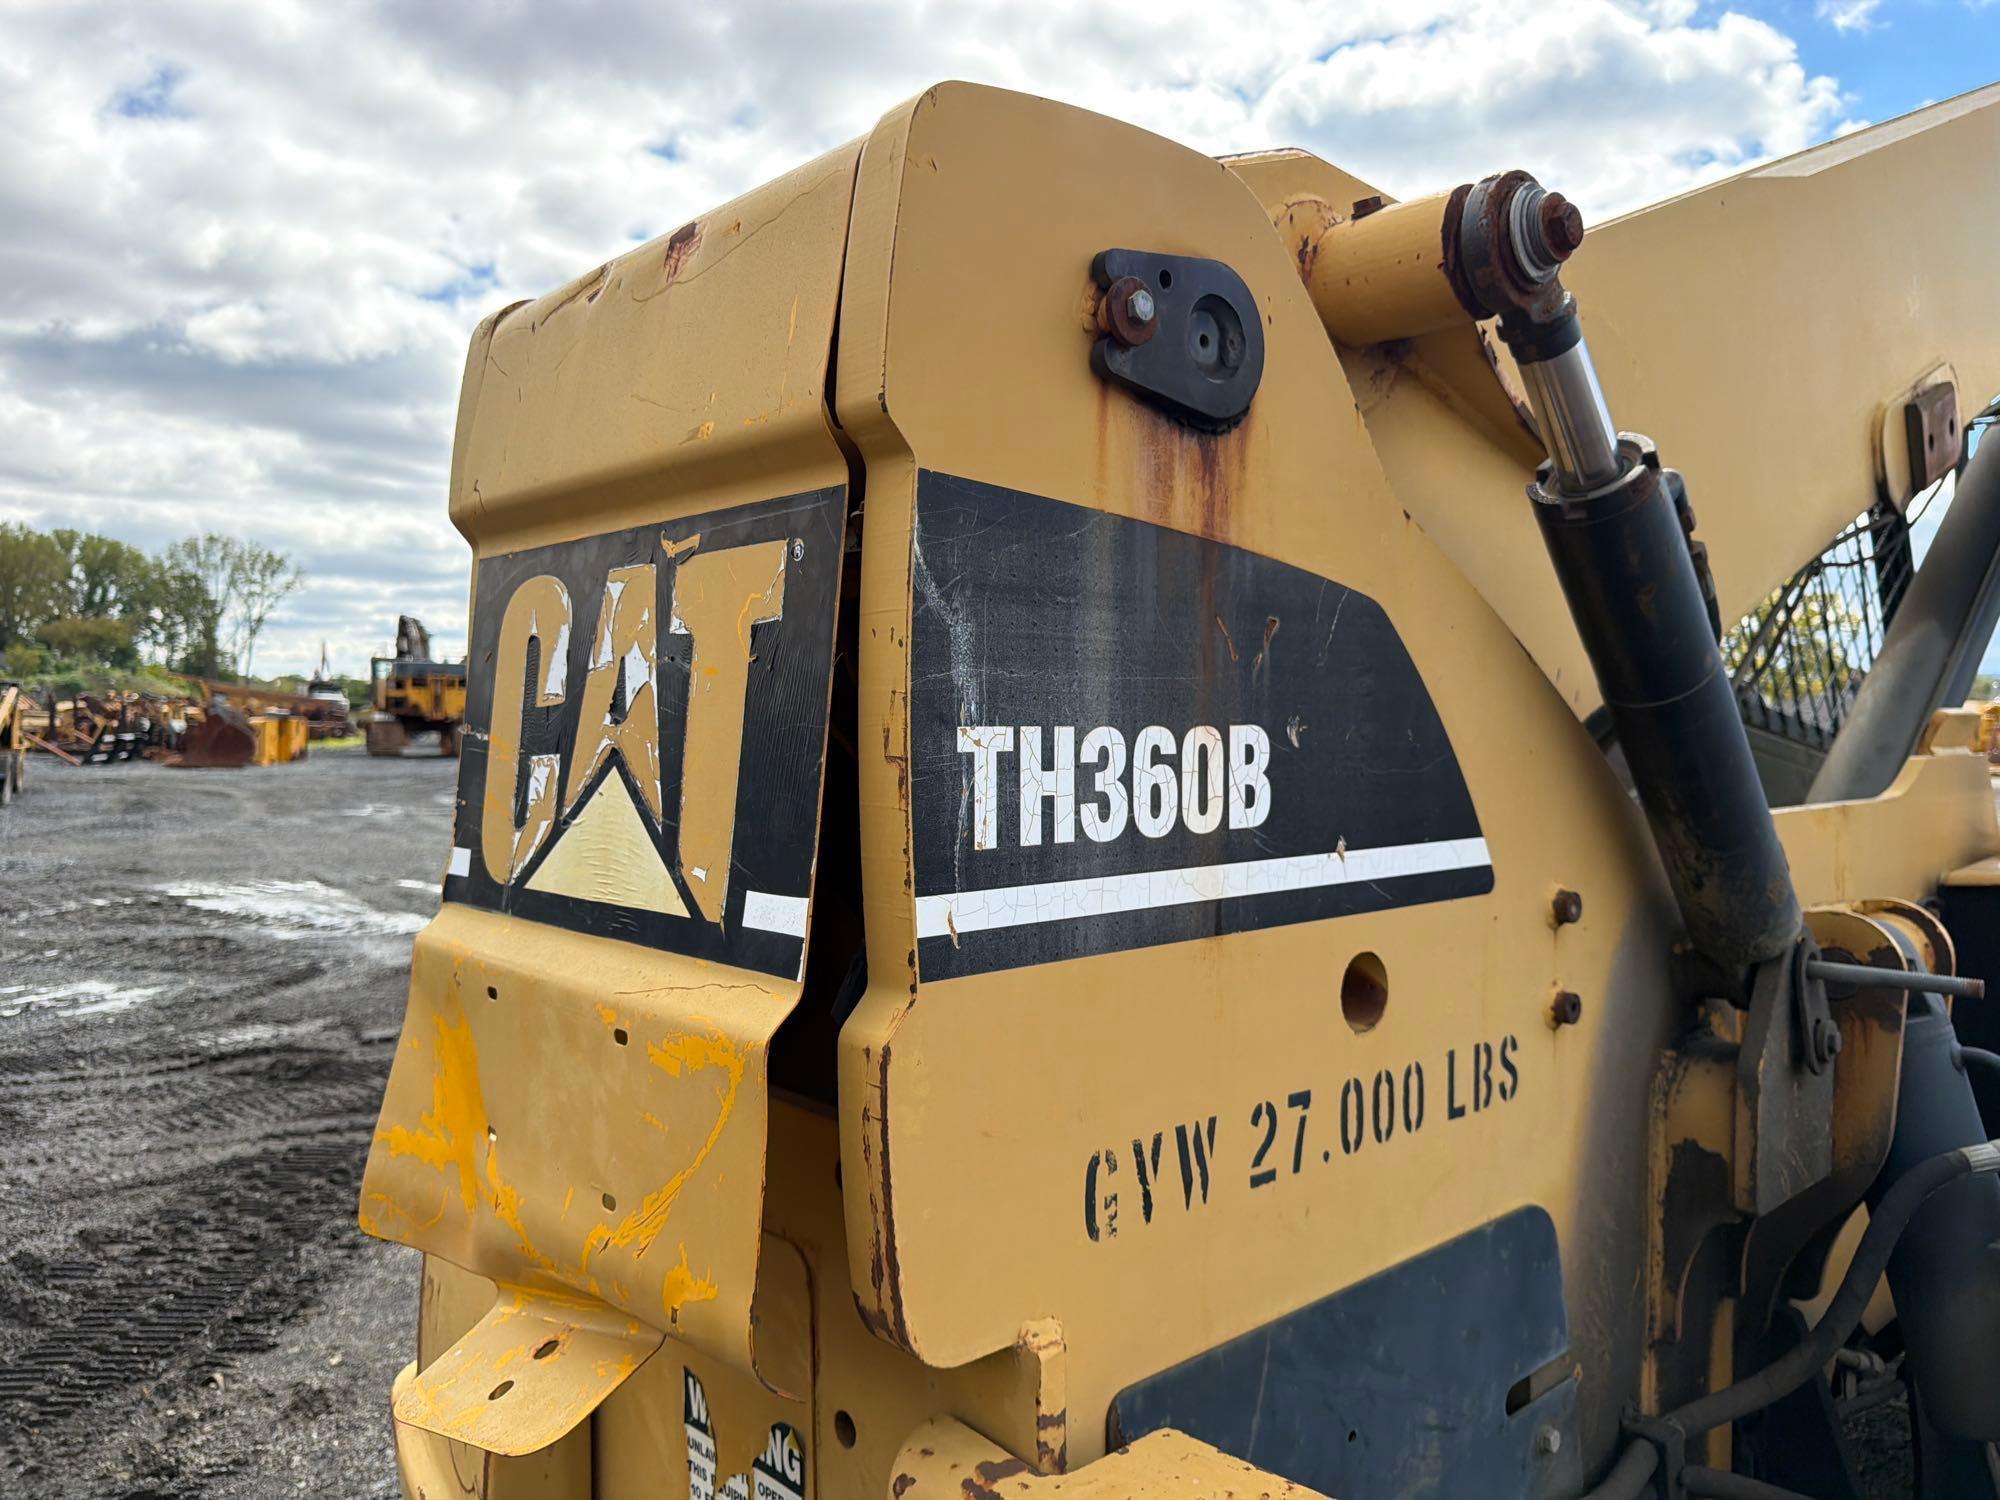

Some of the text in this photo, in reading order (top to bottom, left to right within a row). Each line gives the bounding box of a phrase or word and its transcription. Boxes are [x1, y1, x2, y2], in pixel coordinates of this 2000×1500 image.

[482, 539, 788, 924] CAT
[957, 724, 1271, 850] TH360B
[1085, 1034, 1518, 1242] GVW 27.000 LBS
